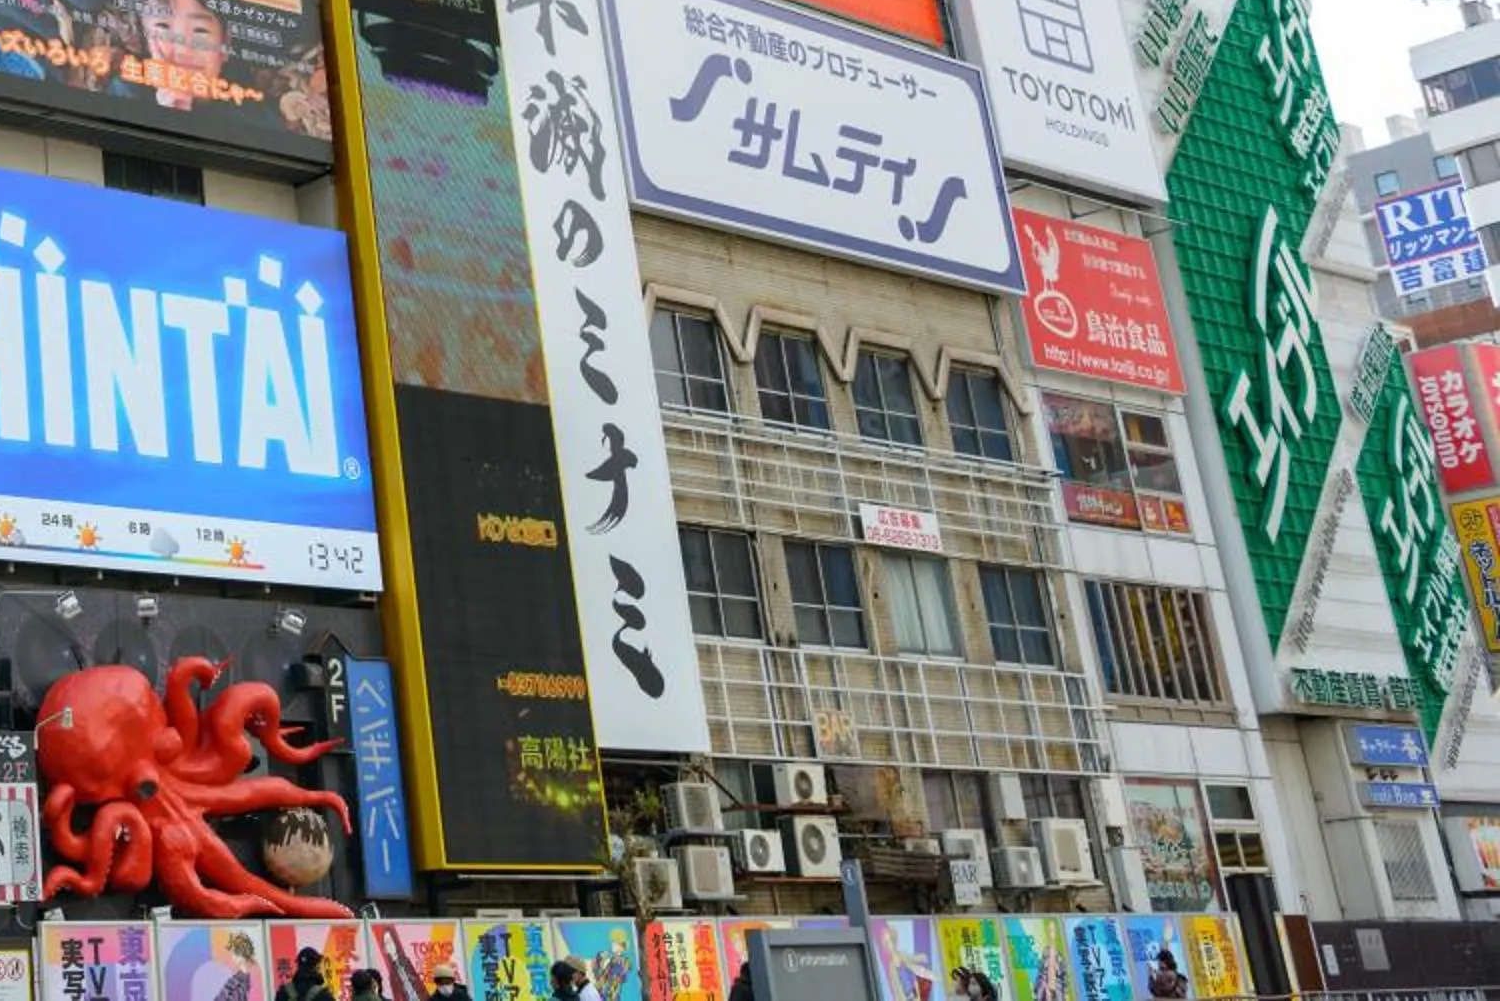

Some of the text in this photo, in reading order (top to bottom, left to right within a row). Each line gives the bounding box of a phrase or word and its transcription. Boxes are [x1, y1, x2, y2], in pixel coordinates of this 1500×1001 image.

[683, 4, 939, 101] 総合不動産のプロデューサー
[1002, 65, 1136, 131] TOYOTOMI
[727, 97, 917, 205] サムティ
[1044, 115, 1110, 148] HOLDINGS
[1389, 227, 1477, 261] リッツマン
[1228, 224, 1319, 499] エイブル
[1418, 375, 1459, 469] JOYSOUND
[1440, 370, 1483, 464] カラオケ
[41, 512, 74, 529] 24時
[196, 526, 226, 543] 12時
[327, 658, 346, 723] 2F
[817, 712, 852, 742] BAR
[3, 762, 30, 782] 2F
[952, 861, 979, 883] BAR
